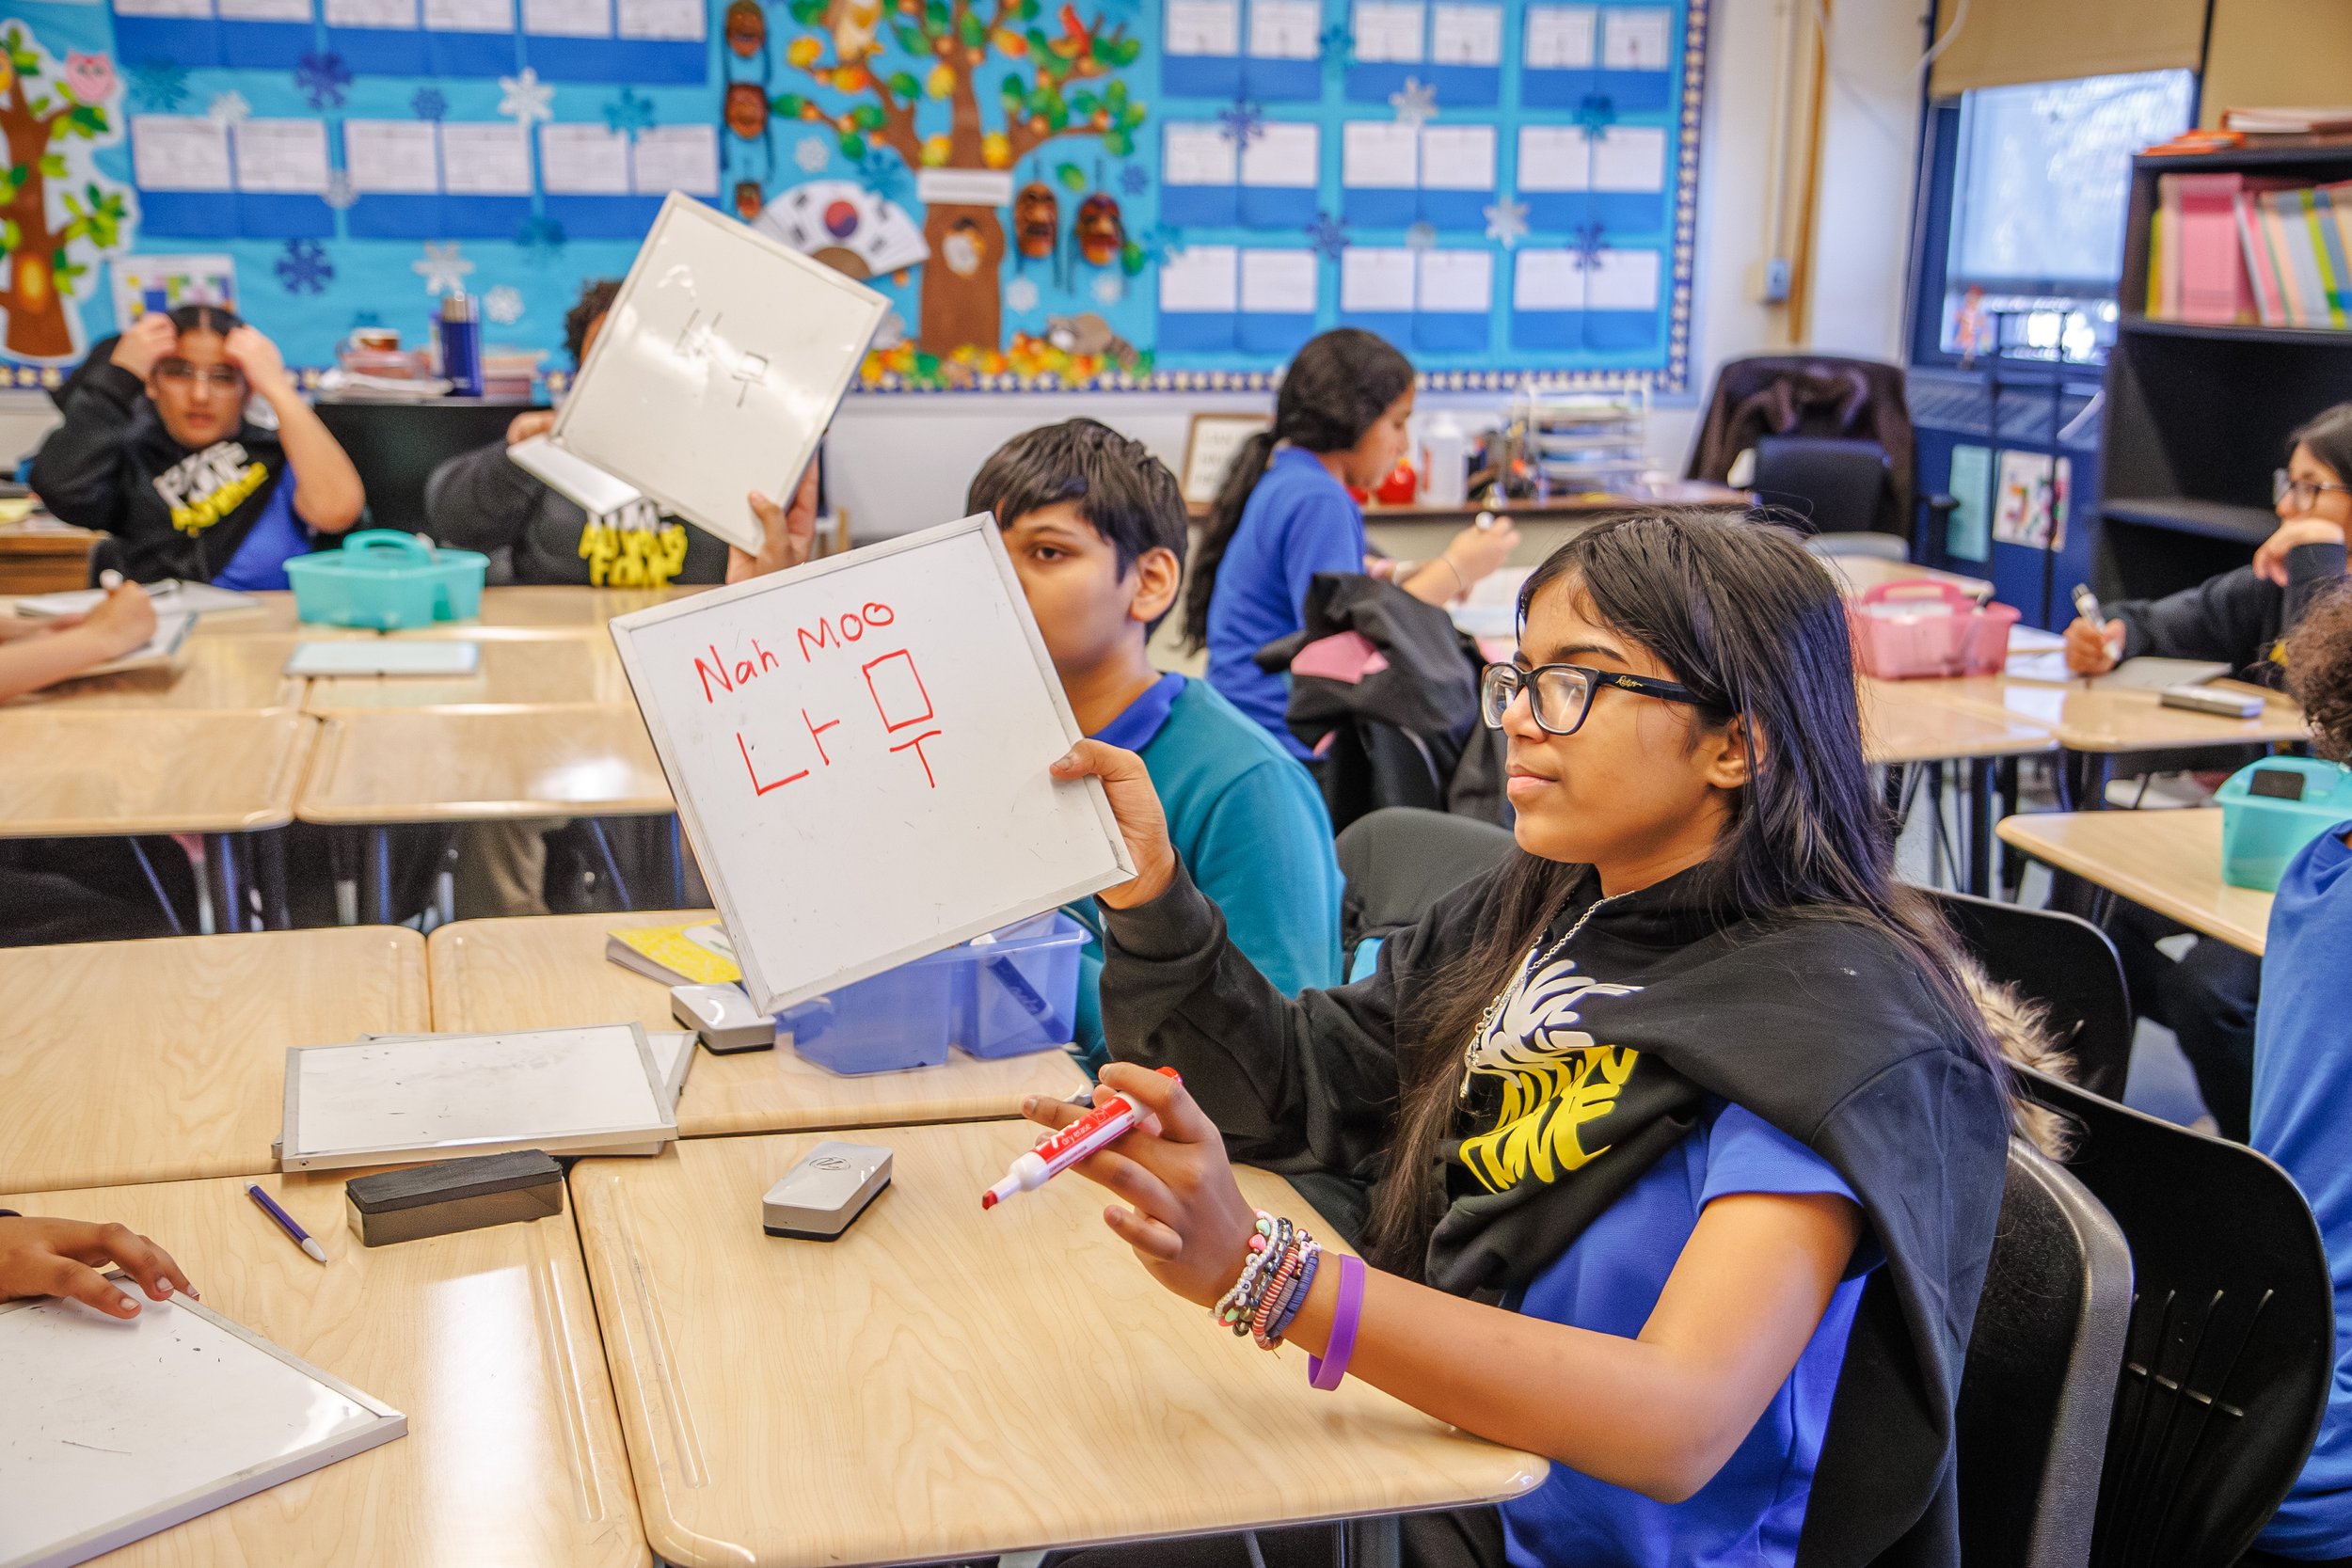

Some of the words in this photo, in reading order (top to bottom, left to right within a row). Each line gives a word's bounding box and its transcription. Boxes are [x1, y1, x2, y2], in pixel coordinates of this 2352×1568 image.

[694, 638, 780, 704] Nah
[1060, 1132, 1076, 1147] dry
[1073, 1123, 1092, 1139] erase
